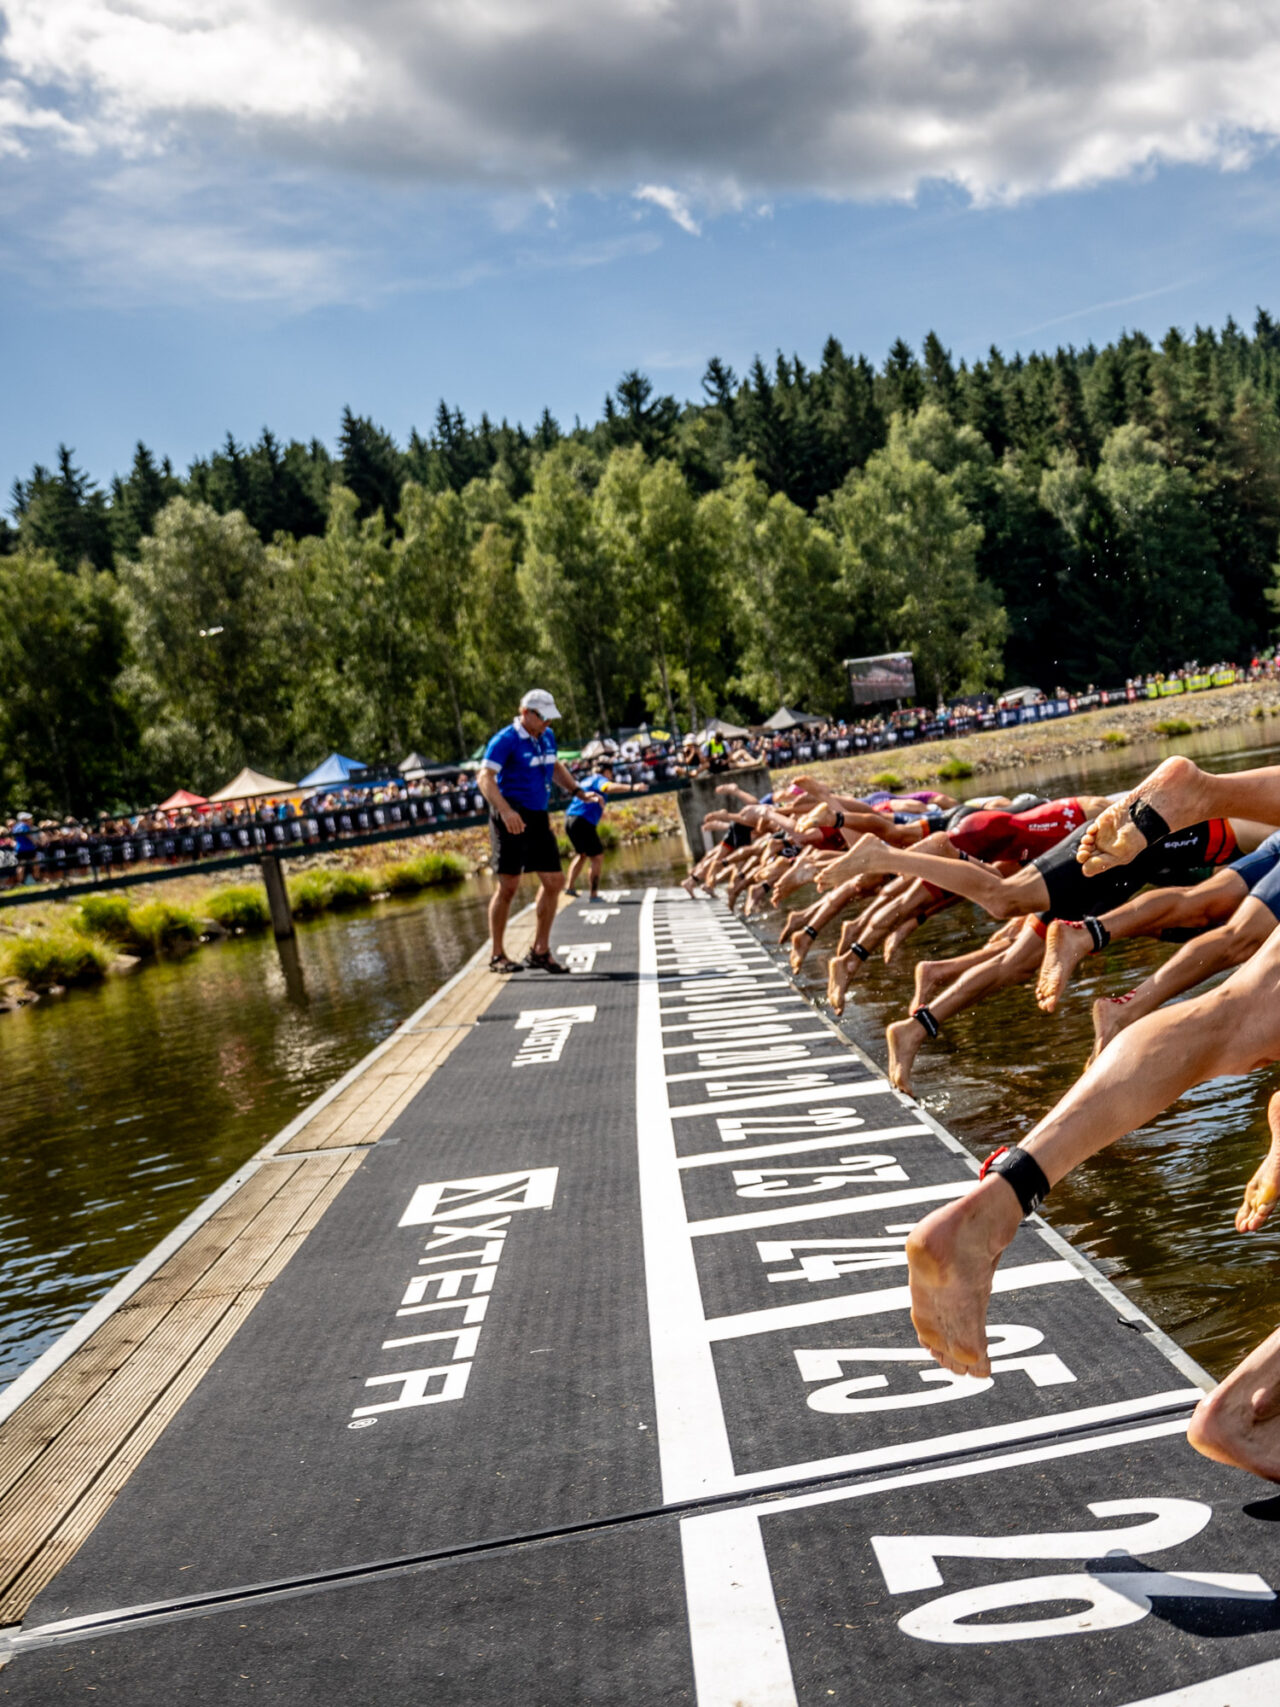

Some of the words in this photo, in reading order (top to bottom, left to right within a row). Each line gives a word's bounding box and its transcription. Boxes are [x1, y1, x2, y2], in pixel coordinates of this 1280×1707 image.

[705, 1073, 834, 1097] 21
[716, 1107, 865, 1142] 22
[732, 1154, 910, 1198] 23
[756, 1222, 915, 1283] 24
[351, 1215, 513, 1418] XTERRA
[793, 1324, 1077, 1414] 25
[870, 1497, 1277, 1644] 26
